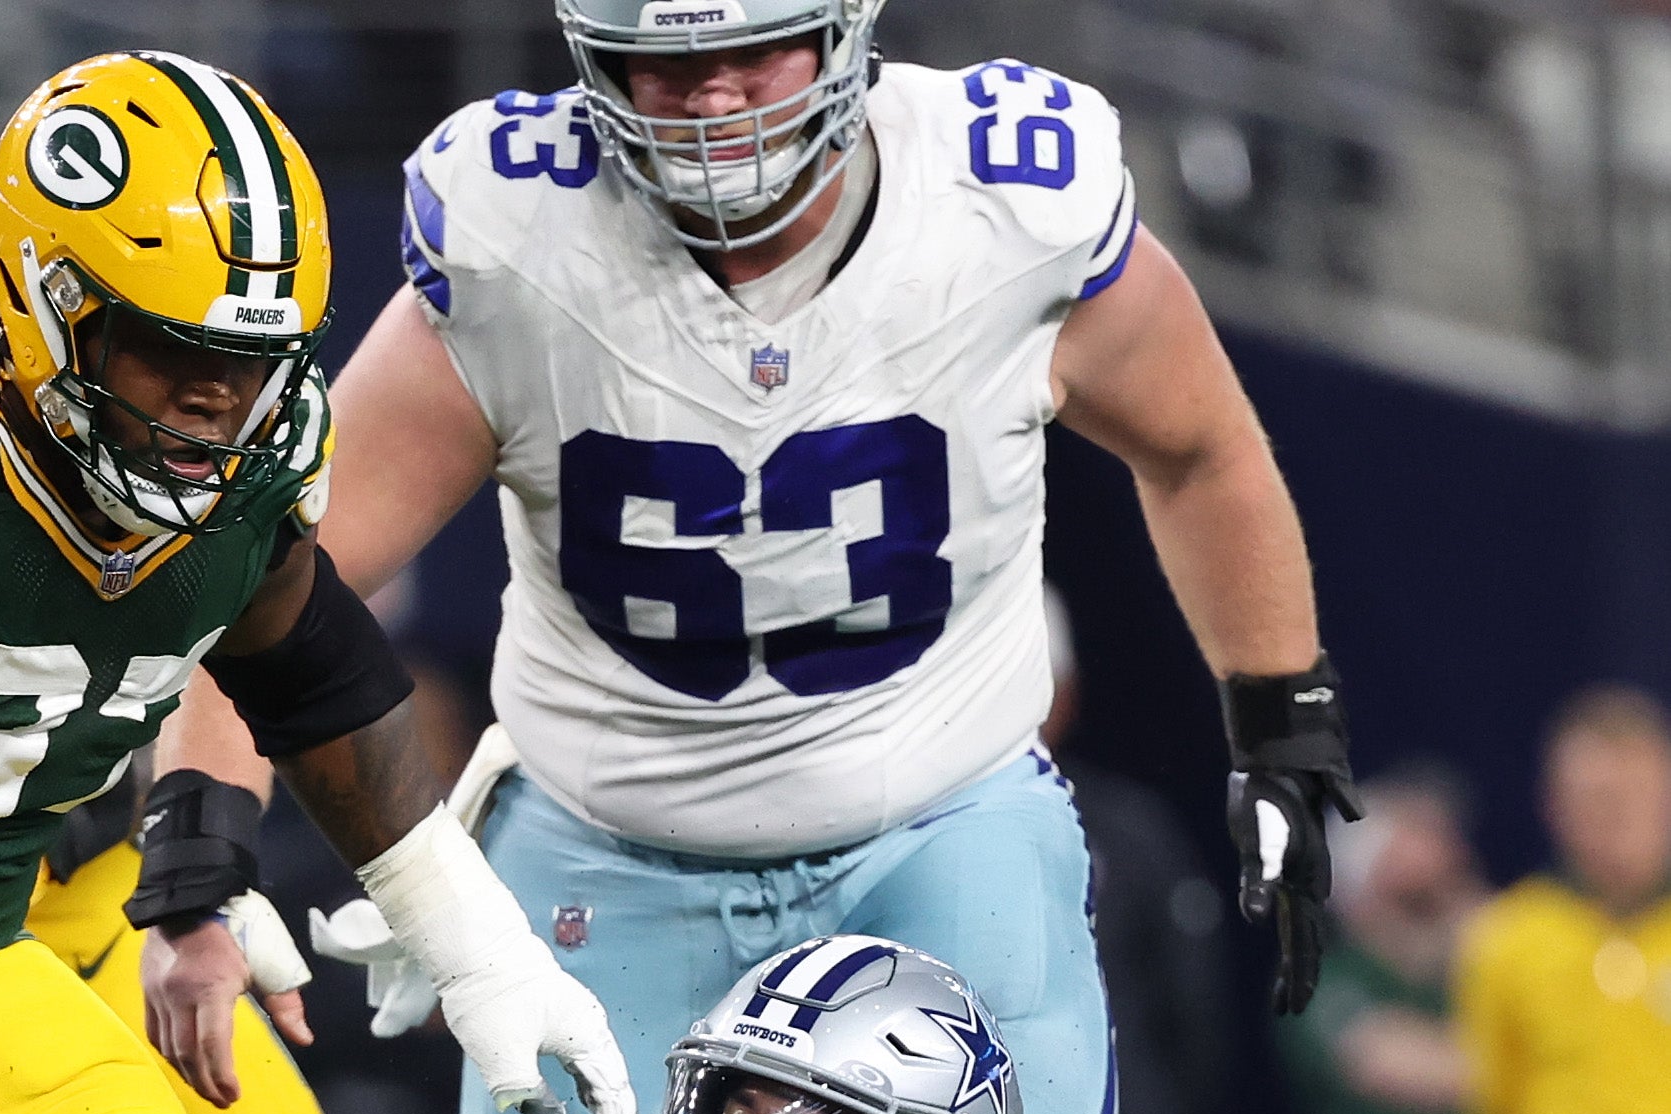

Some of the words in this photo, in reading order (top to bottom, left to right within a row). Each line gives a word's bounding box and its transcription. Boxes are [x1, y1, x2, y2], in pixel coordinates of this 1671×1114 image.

[27, 105, 128, 208] G
[234, 306, 286, 326] PACKERS
[560, 413, 952, 702] 63
[733, 1023, 798, 1048] COWBOYS
